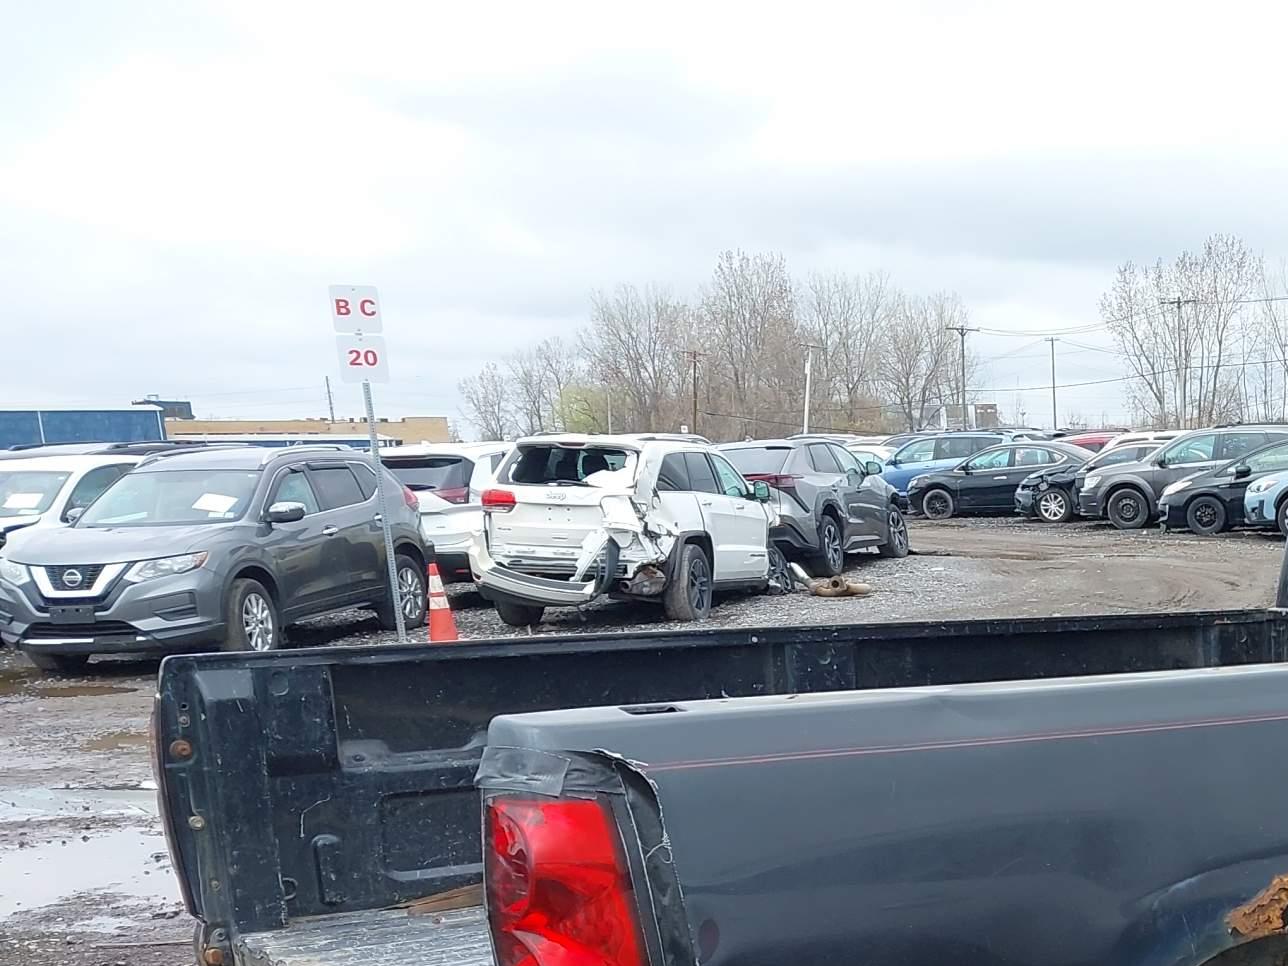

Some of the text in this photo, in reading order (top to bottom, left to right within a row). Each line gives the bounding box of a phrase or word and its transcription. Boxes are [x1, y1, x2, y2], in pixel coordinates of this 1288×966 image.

[335, 298, 377, 317] B C
[348, 349, 378, 367] 20
